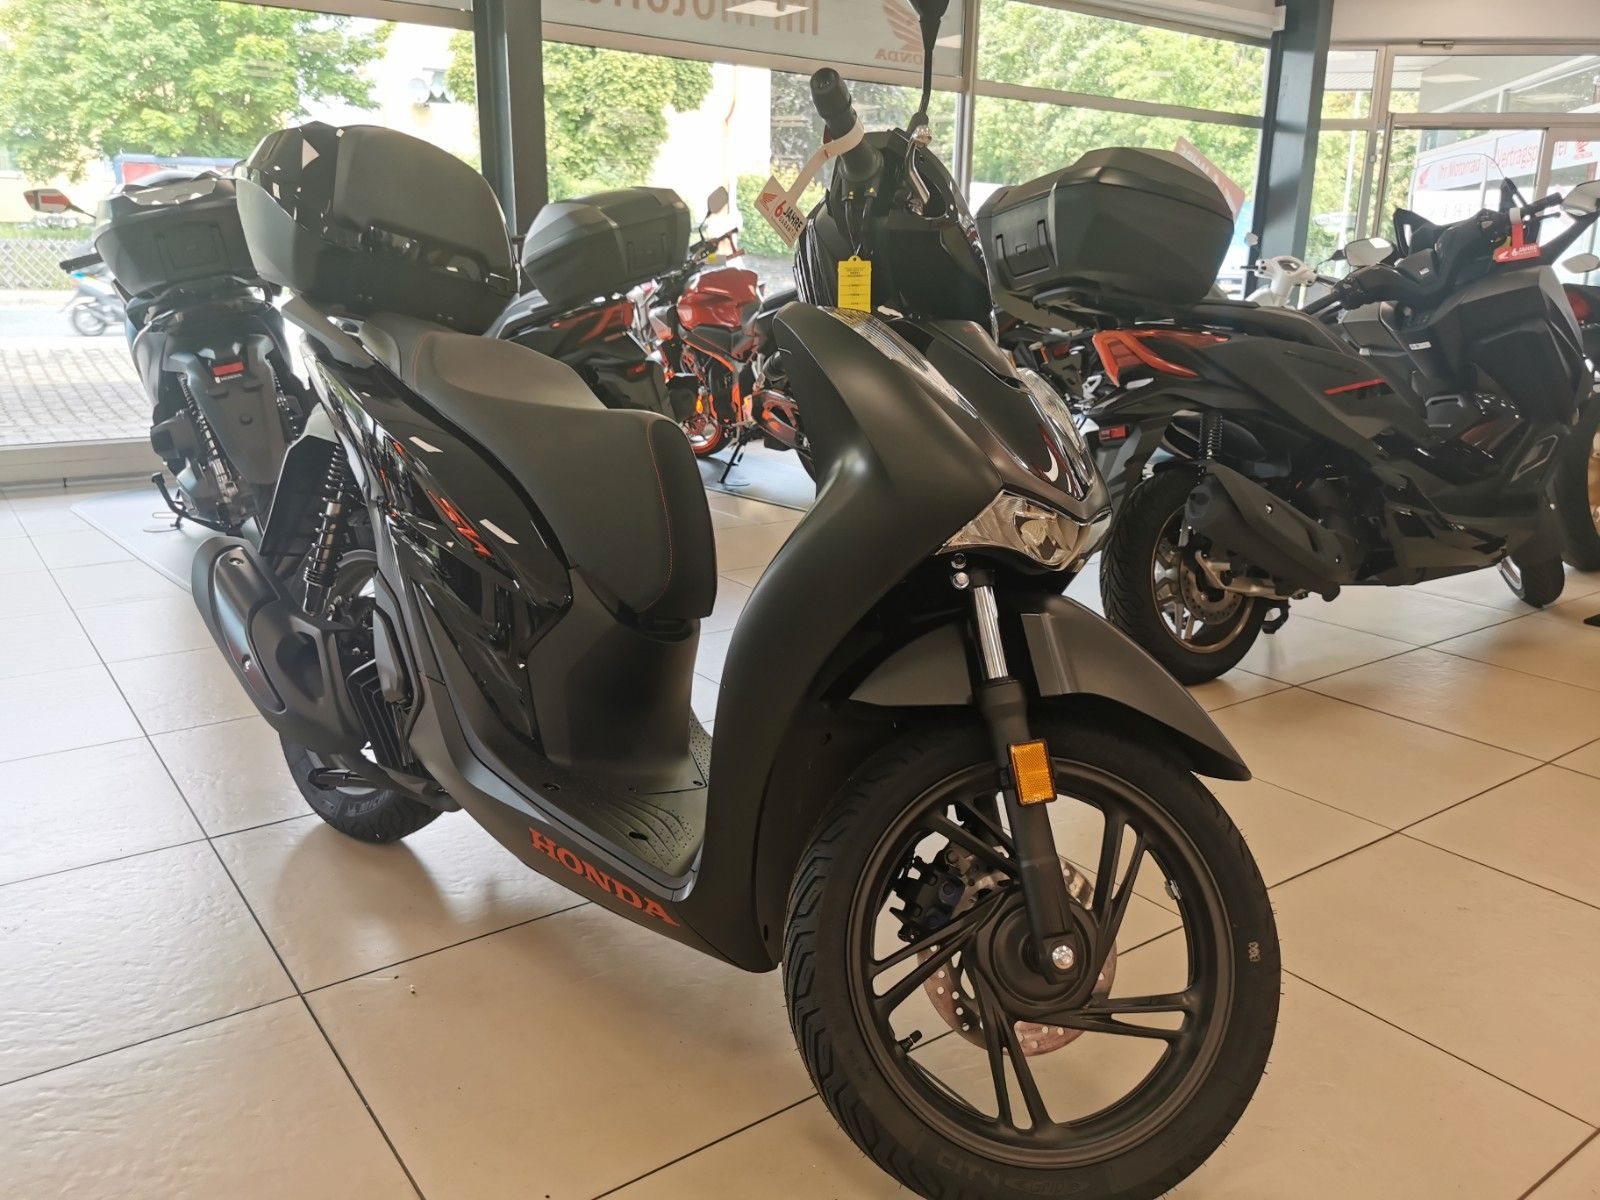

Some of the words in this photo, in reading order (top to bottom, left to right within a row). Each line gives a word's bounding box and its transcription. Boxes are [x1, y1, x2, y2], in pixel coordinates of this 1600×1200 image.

[774, 200, 787, 217] 6
[783, 206, 804, 232] JAHRE
[529, 827, 680, 927] HONDA
[936, 1150, 999, 1187] CITY
